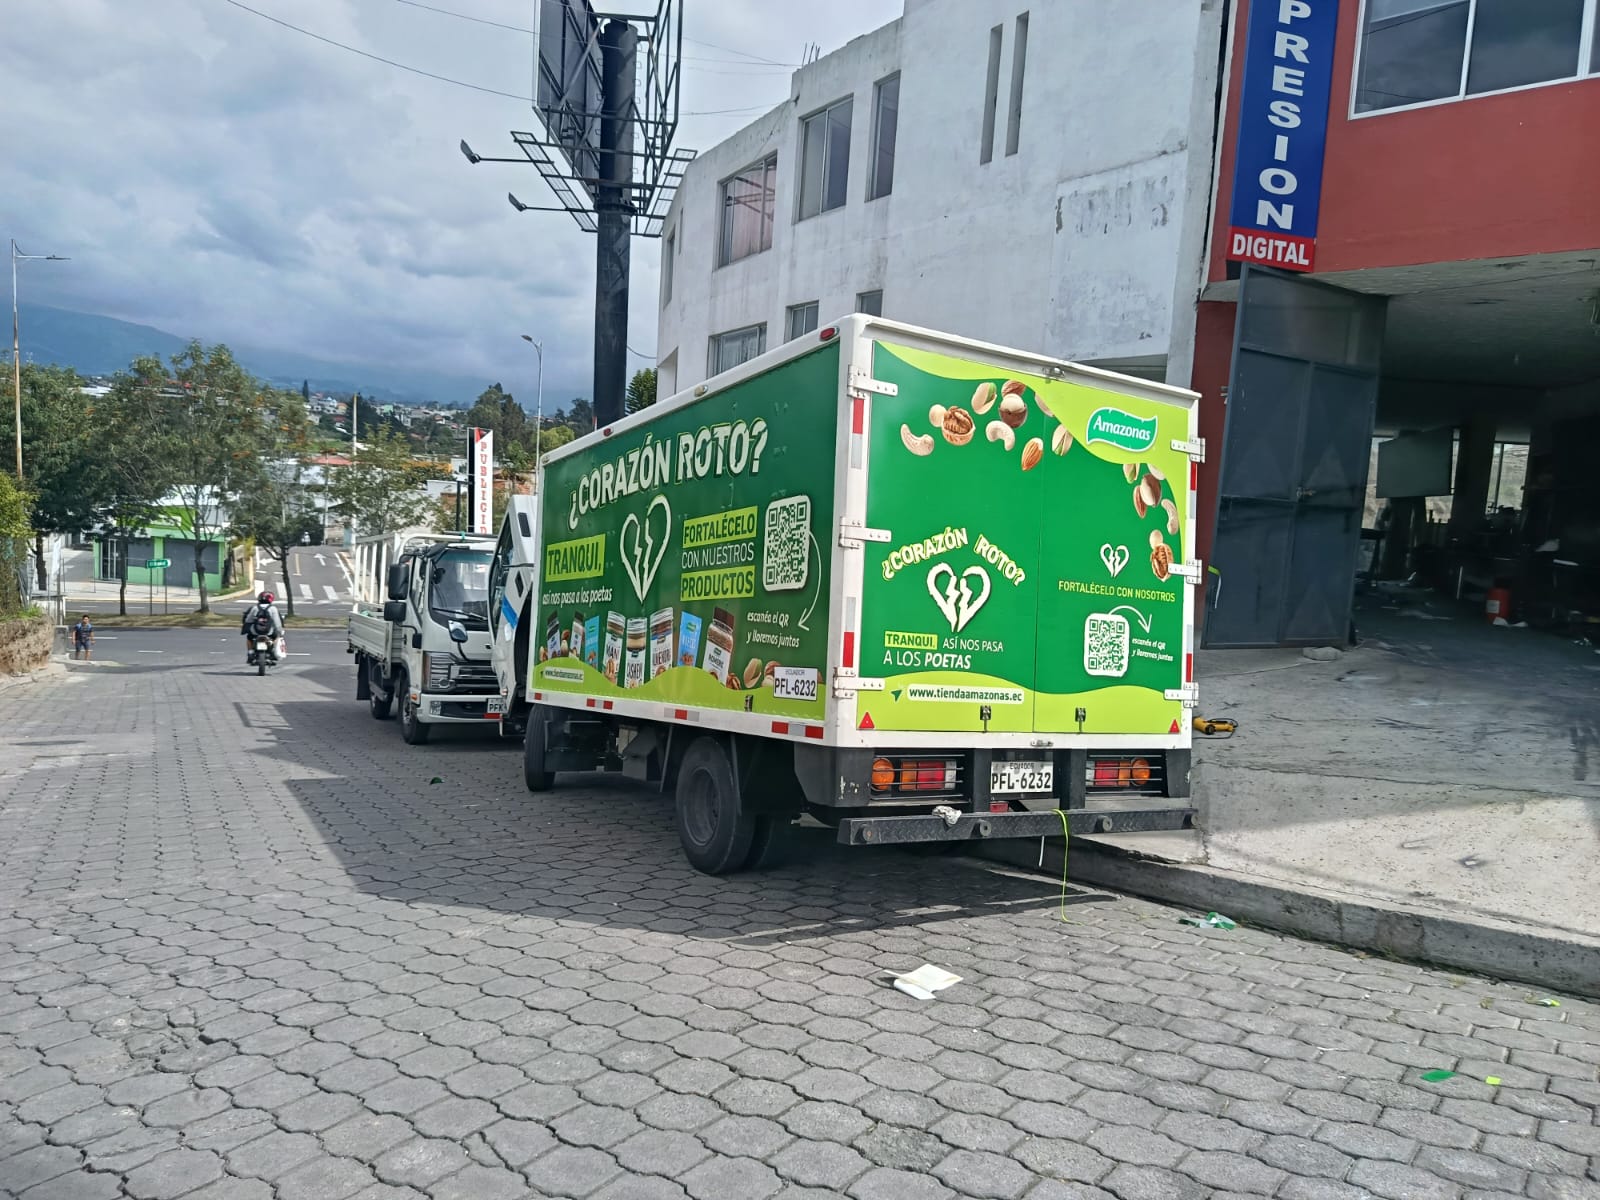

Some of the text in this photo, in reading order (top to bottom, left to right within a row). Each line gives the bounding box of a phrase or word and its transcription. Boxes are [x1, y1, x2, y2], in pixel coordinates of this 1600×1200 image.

[1232, 233, 1310, 266] DIGITAL
[1093, 415, 1151, 441] Amazonas
[568, 420, 768, 530] ¿CORAZÓN ROTO?
[683, 513, 756, 545] FORTALÉCELO
[547, 543, 602, 576] TRANQUI,
[682, 543, 755, 568] CON NUESTROS
[881, 527, 1026, 587] ¿CORAZÓN ROTO?
[682, 571, 754, 597] PRODUCTOS
[1058, 580, 1176, 603] FORTALÉCELO CON NOSOTROS
[551, 592, 561, 605] nos
[560, 592, 576, 608] pasa
[576, 592, 580, 603] a
[581, 586, 590, 603] los
[589, 585, 613, 608] poetas
[772, 612, 779, 624] el
[779, 613, 790, 628] QR
[746, 629, 800, 648] y lloremos juntos
[943, 636, 1004, 653] ASÍ NOS PASA
[883, 650, 972, 670] A LOS POETAS
[774, 677, 816, 697] PFL-6232
[909, 687, 1023, 702] www.tiendaamazonas.ec
[991, 772, 1052, 790] PFL-6232
